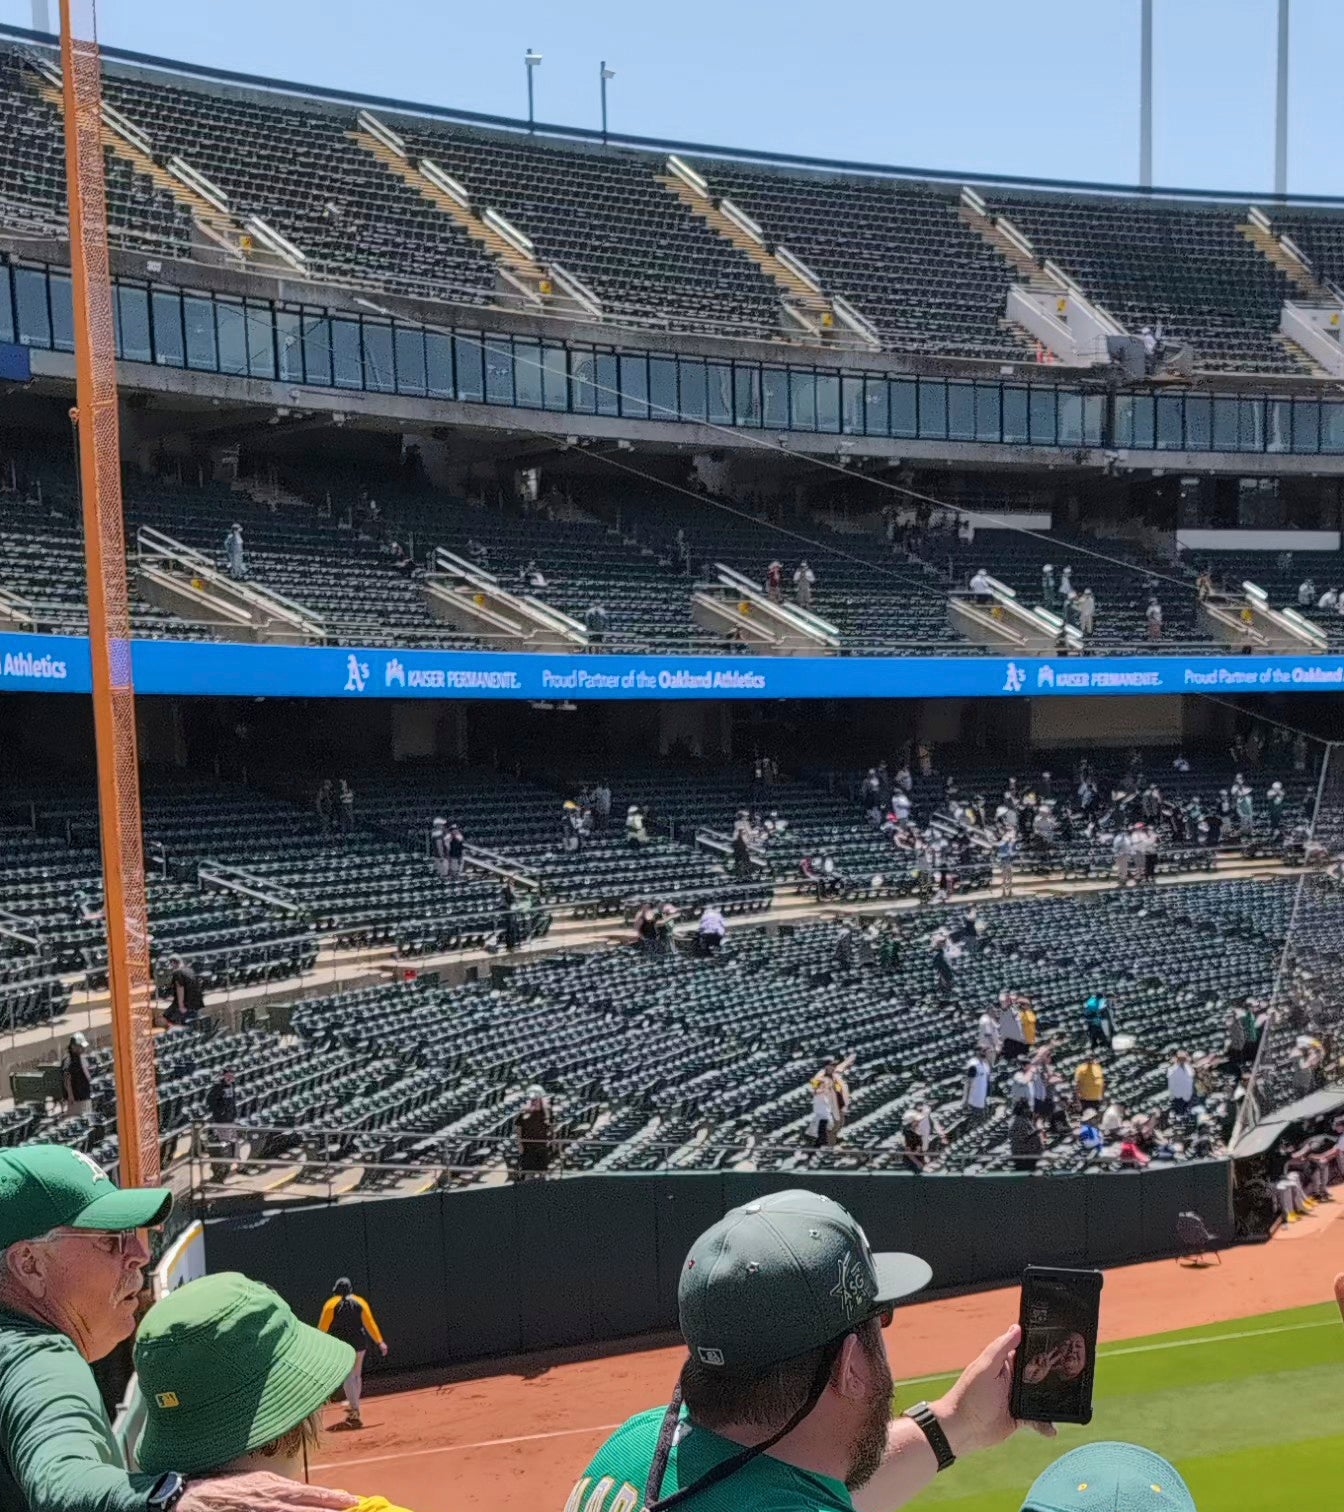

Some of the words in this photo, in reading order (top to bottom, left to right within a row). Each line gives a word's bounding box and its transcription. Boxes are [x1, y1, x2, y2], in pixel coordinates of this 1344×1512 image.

[4, 652, 67, 679] Athletics
[408, 670, 445, 687] KAISER
[542, 669, 577, 688] Proud
[578, 669, 619, 688] Partner
[621, 669, 636, 688] of
[637, 670, 657, 688] the
[658, 670, 712, 689] Oakland
[713, 671, 766, 689] Athletics
